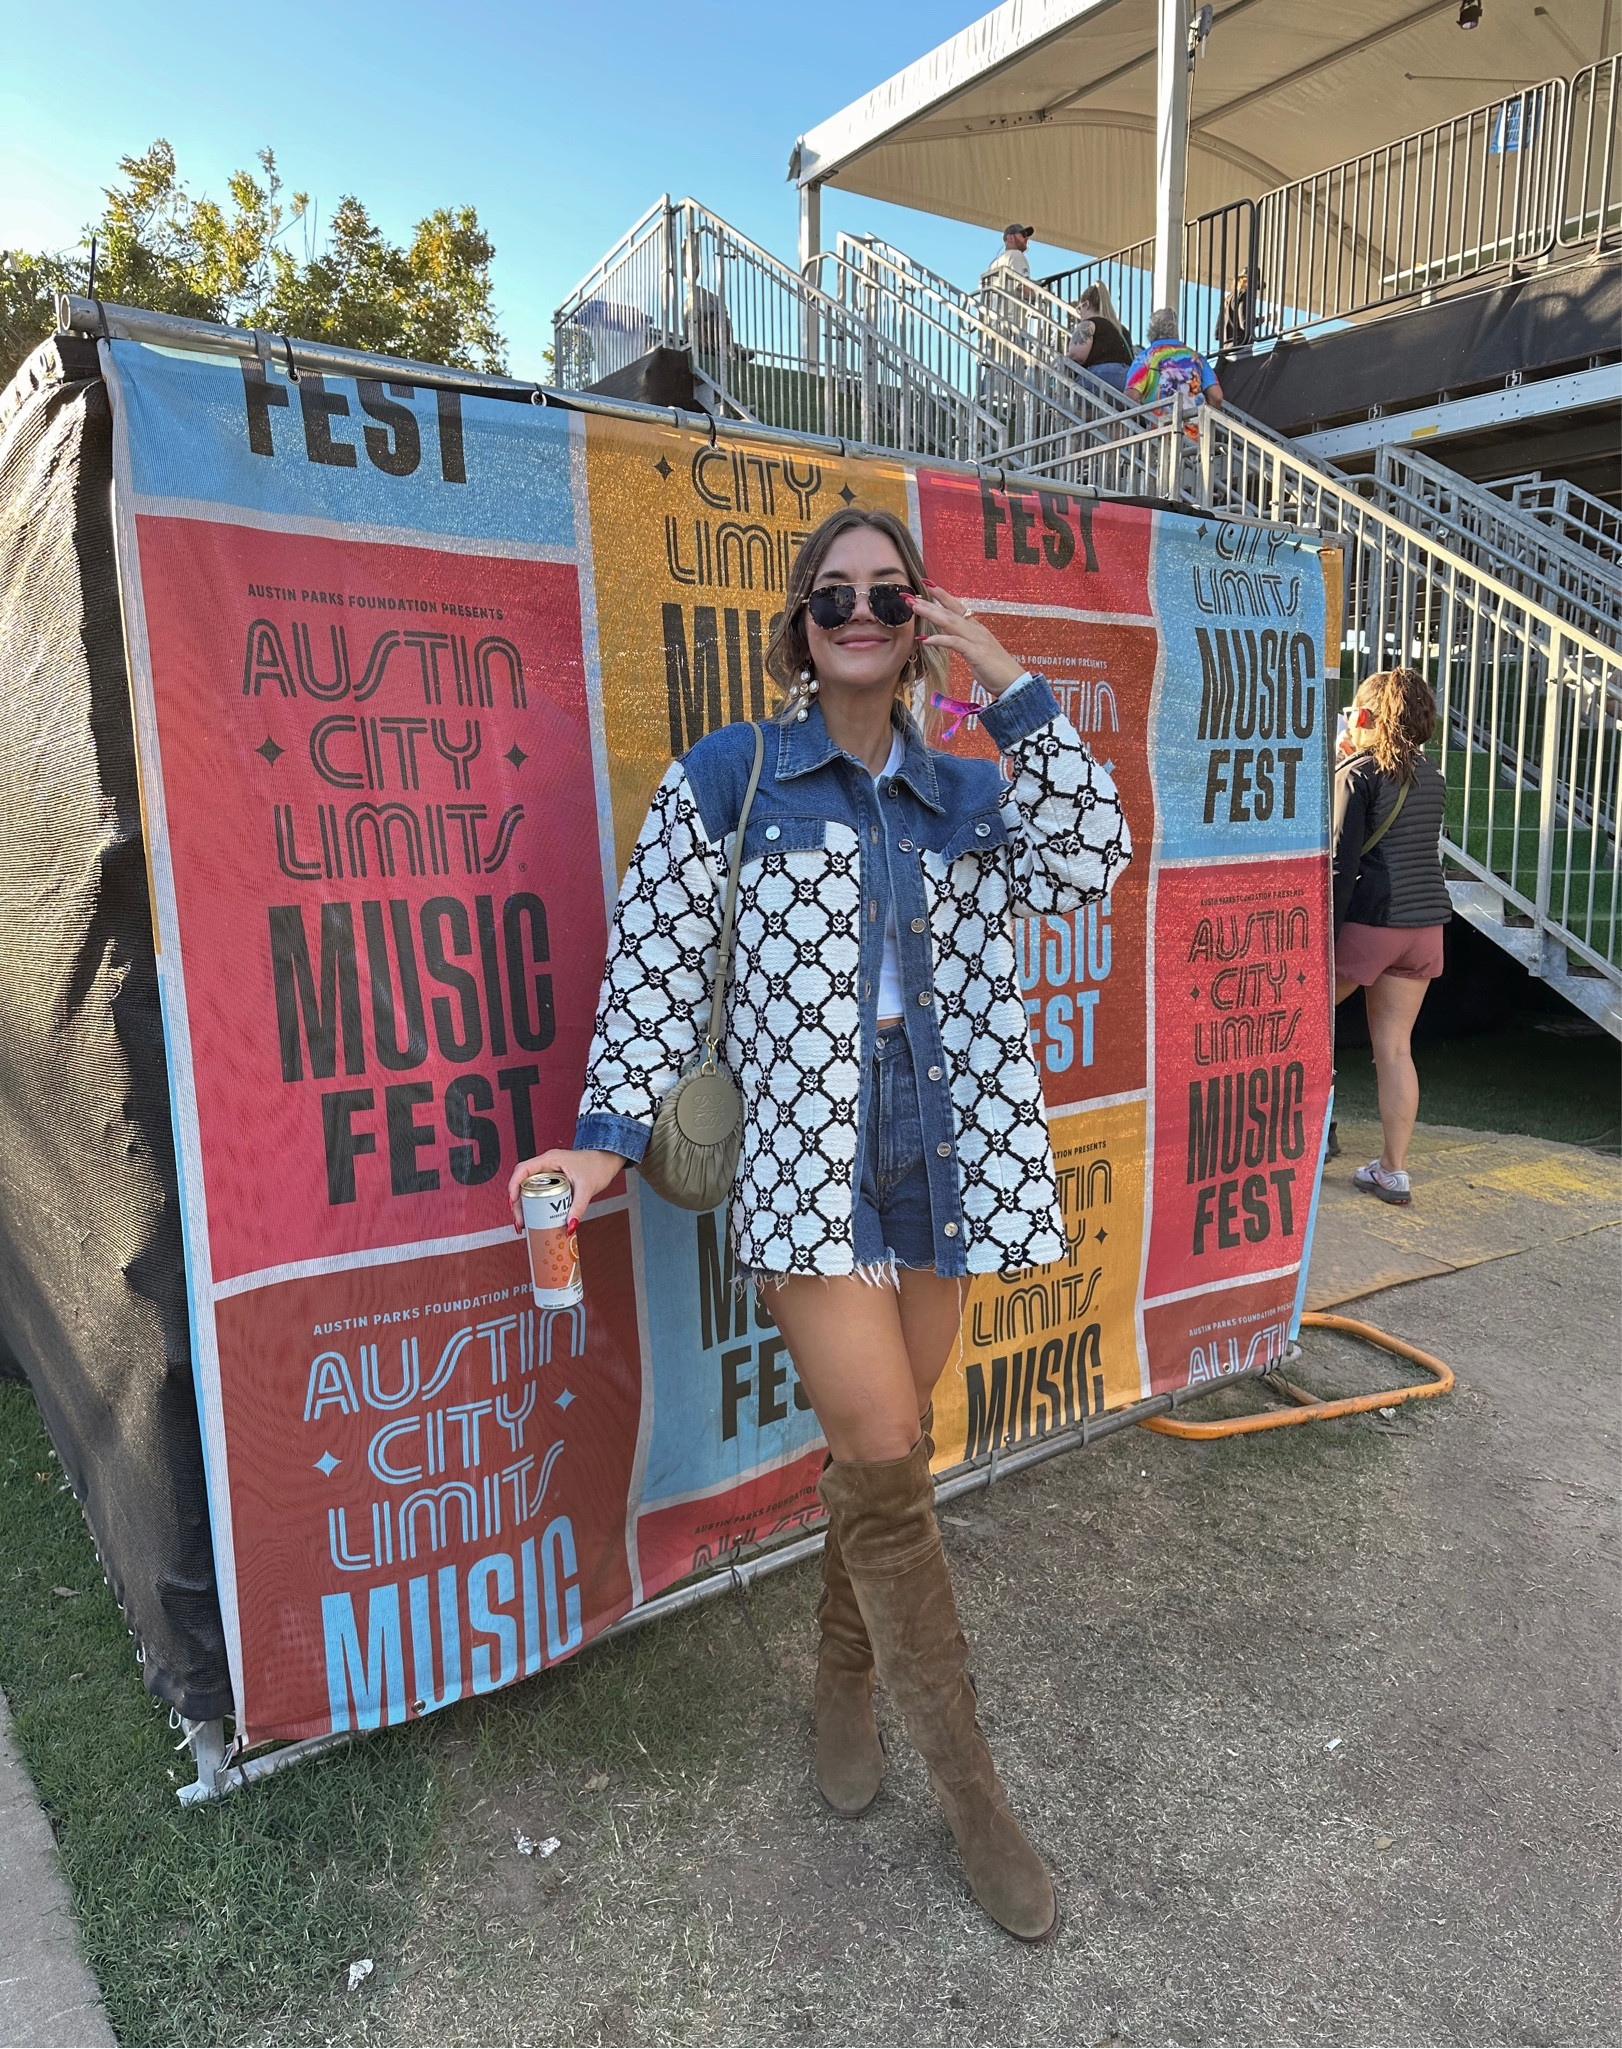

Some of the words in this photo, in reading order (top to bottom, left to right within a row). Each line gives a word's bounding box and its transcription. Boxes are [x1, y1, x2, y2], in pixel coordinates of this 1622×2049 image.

[240, 356, 467, 484] FEST
[691, 445, 822, 521] CITY
[665, 515, 812, 593] LIMI
[980, 479, 1100, 573] FEST
[248, 583, 296, 601] AUSTIN
[302, 590, 344, 606] PARKS
[349, 595, 437, 613] FOUNDATION
[441, 604, 504, 621] PRESENTS
[1193, 565, 1300, 617] LIMITS
[242, 618, 528, 709] AUSTIN
[1195, 626, 1316, 741] MUSIC
[309, 714, 482, 791] CITY
[1203, 747, 1303, 824] FEST
[274, 801, 526, 881] LIMITS
[1015, 895, 1112, 990] USIC
[1187, 905, 1309, 964] AUSTIN
[267, 891, 557, 1083] MUSIC
[1210, 960, 1287, 1012] CITY
[1194, 1010, 1300, 1067] LIMITS
[321, 1065, 541, 1206] FEST
[1074, 1140, 1107, 1155] PRESENTS
[1186, 1060, 1307, 1184] MUSIC
[550, 1195, 571, 1213] VIZ
[1191, 1167, 1296, 1257] FEST
[313, 1316, 368, 1336] AUSTIN
[373, 1307, 420, 1325] PARKS
[424, 1289, 509, 1316] FOUNDATION
[972, 1266, 1103, 1347] LIMITS
[1189, 1324, 1211, 1336] AUSTIN
[1213, 1318, 1237, 1329] PARKS
[1238, 1308, 1276, 1324] FOUNDATION
[303, 1302, 586, 1421] AUSTIN
[964, 1322, 1105, 1460] MUSIC
[1187, 1321, 1288, 1385] AUSTI
[367, 1381, 537, 1484] CITY
[328, 1440, 565, 1572] LIMITS
[695, 1520, 732, 1535] AUSTIN
[733, 1508, 764, 1523] PARKS
[320, 1515, 583, 1733] MUSIC
